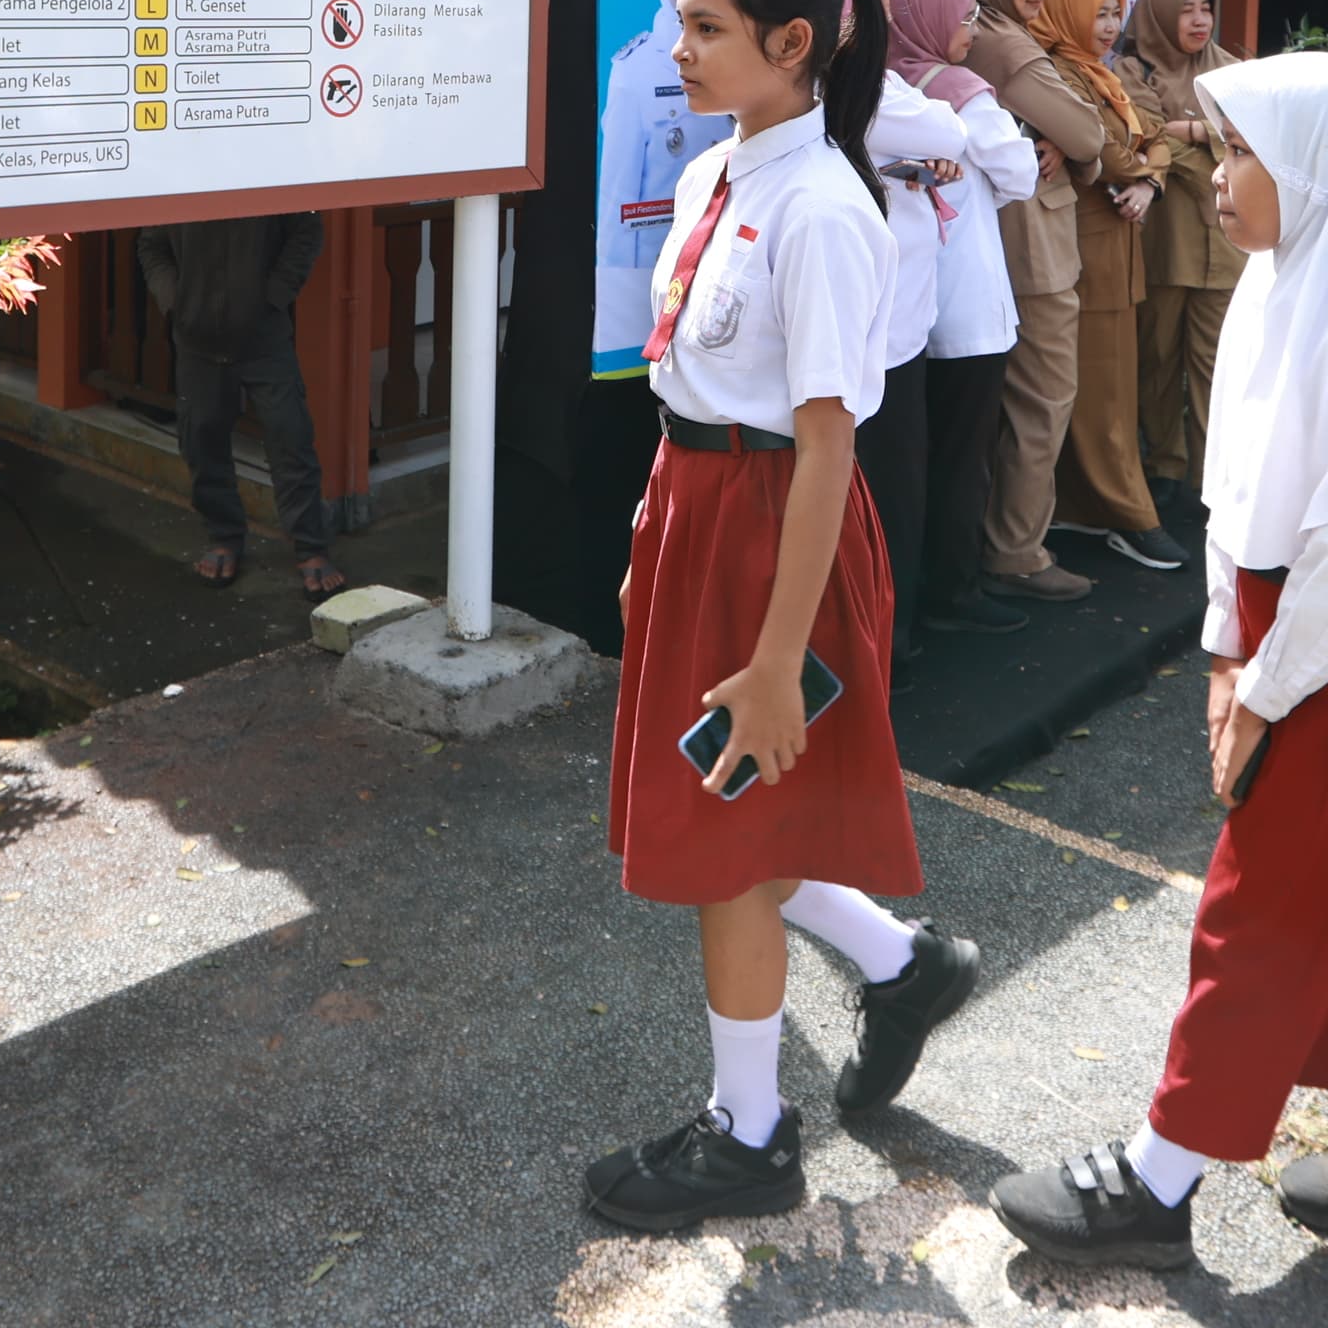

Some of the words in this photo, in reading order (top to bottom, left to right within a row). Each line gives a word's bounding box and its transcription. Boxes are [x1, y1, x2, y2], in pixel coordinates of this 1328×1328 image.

[374, 3, 426, 19] Dilarang
[434, 4, 483, 17] Merusak
[185, 30, 234, 41] Asrama
[237, 30, 267, 41] Putri
[373, 24, 423, 37] Fasilitas
[143, 33, 159, 51] M
[185, 42, 234, 53] Asrama
[237, 42, 270, 53] Putra
[32, 72, 71, 88] Kelas
[144, 70, 157, 88] N
[184, 70, 220, 85] Toilet
[373, 74, 425, 89] Dilarang
[432, 72, 492, 86] Membawa
[372, 94, 418, 109] Senjata
[425, 92, 460, 107] Tajam
[144, 107, 157, 125] N
[184, 107, 233, 121] Asrama
[236, 105, 269, 119] Putra
[41, 150, 91, 166] Perpus,
[96, 146, 123, 162] UKS
